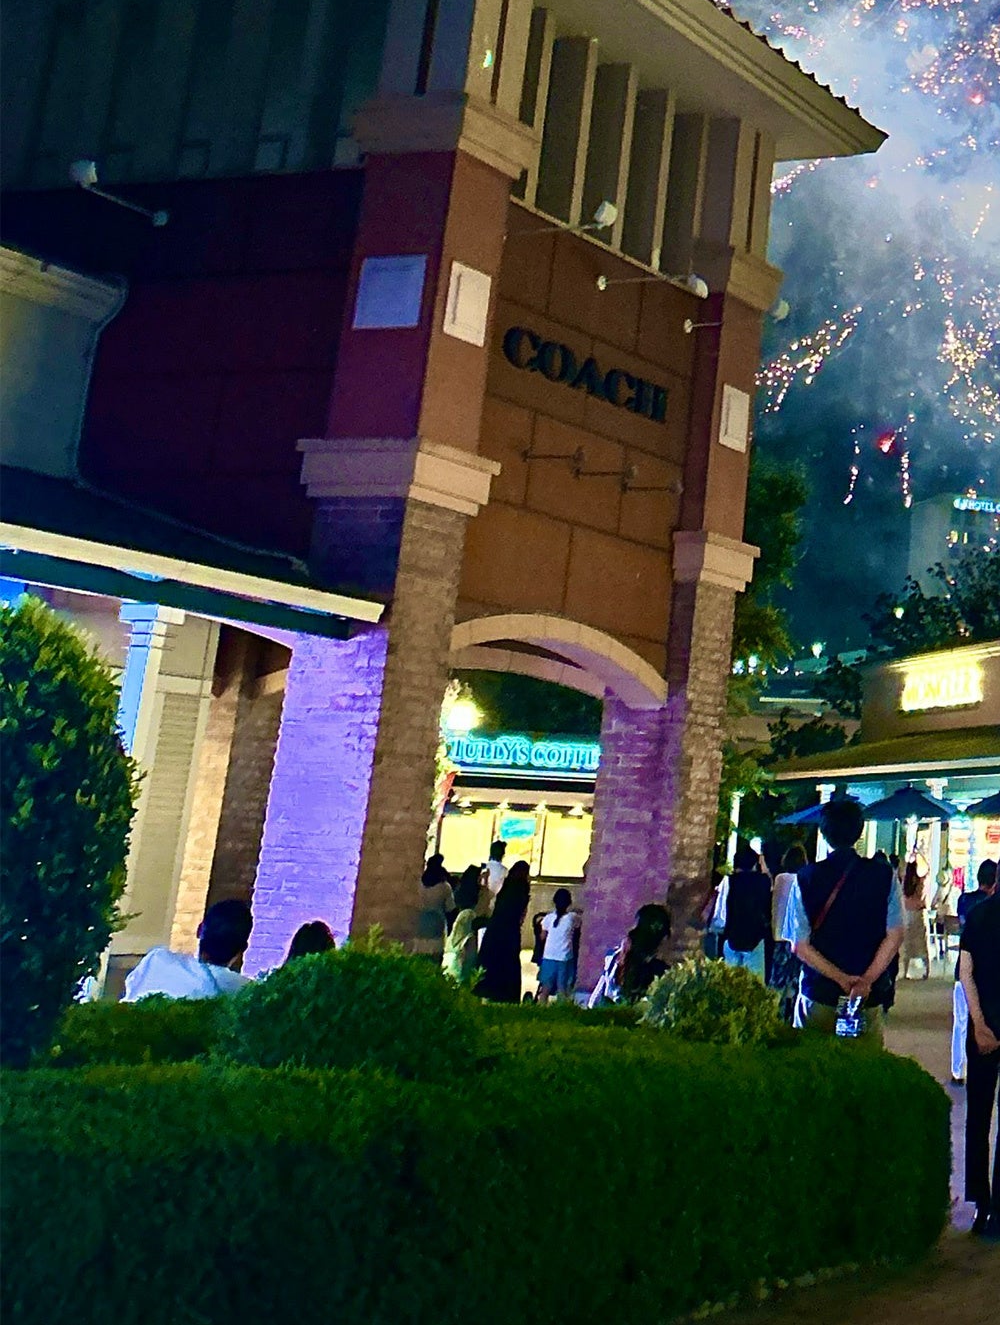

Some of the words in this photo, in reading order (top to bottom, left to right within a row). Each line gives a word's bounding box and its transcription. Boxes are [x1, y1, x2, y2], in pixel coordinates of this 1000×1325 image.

[502, 326, 669, 424] COACH
[449, 736, 530, 764] TULLY'S
[531, 743, 600, 769] COFFE
